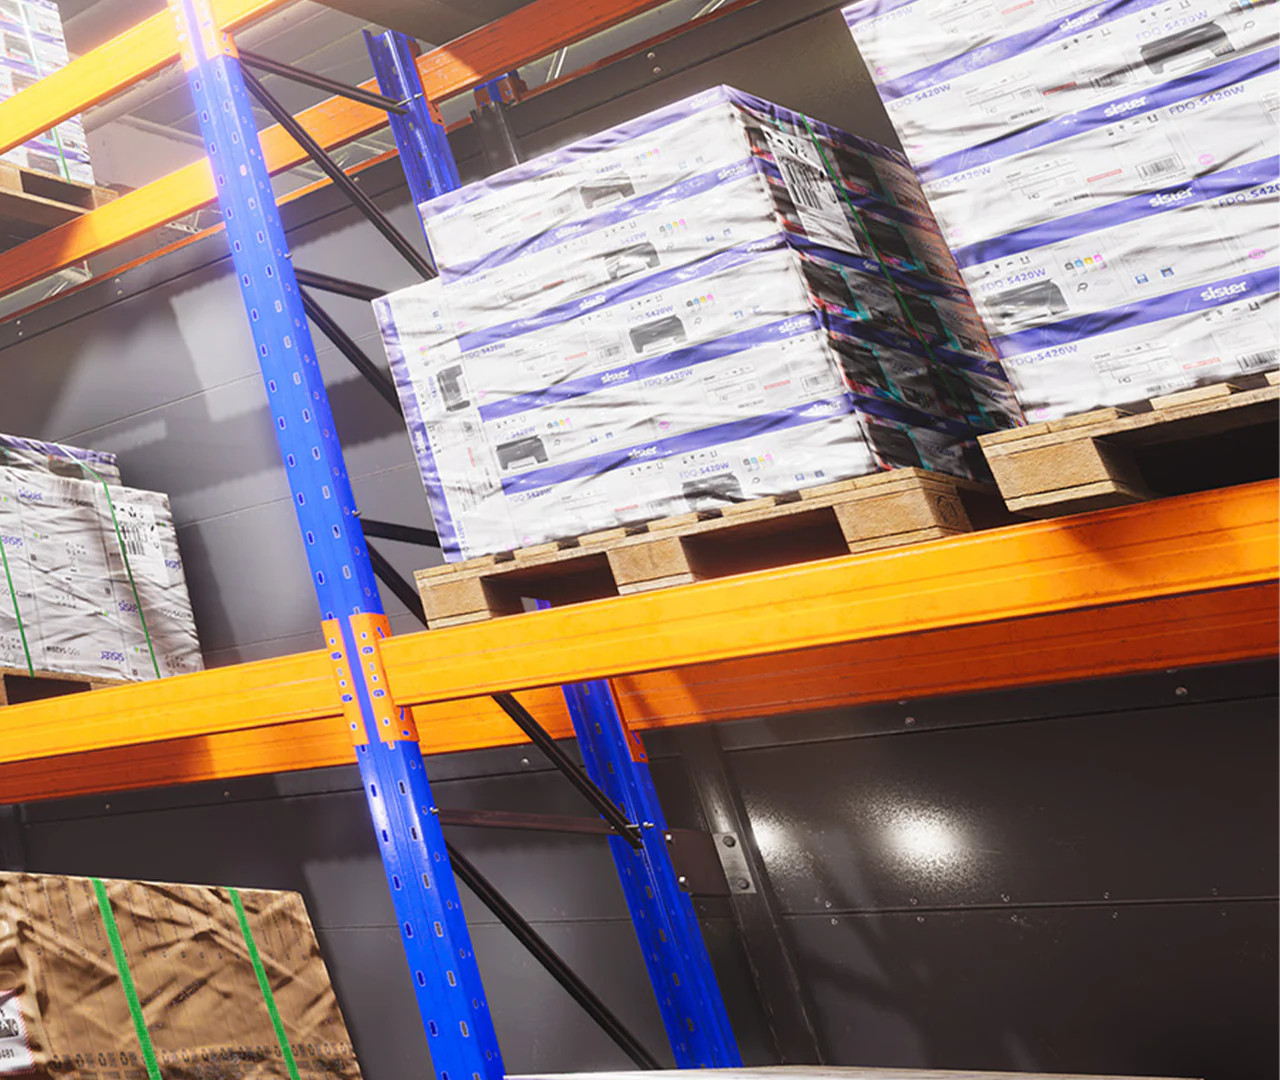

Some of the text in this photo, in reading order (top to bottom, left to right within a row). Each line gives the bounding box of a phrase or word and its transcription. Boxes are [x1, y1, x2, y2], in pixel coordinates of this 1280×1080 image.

[1103, 95, 1149, 118] sister
[1169, 85, 1245, 116] FDQ-S420W
[1148, 187, 1196, 208] sister
[1200, 281, 1249, 302] sister
